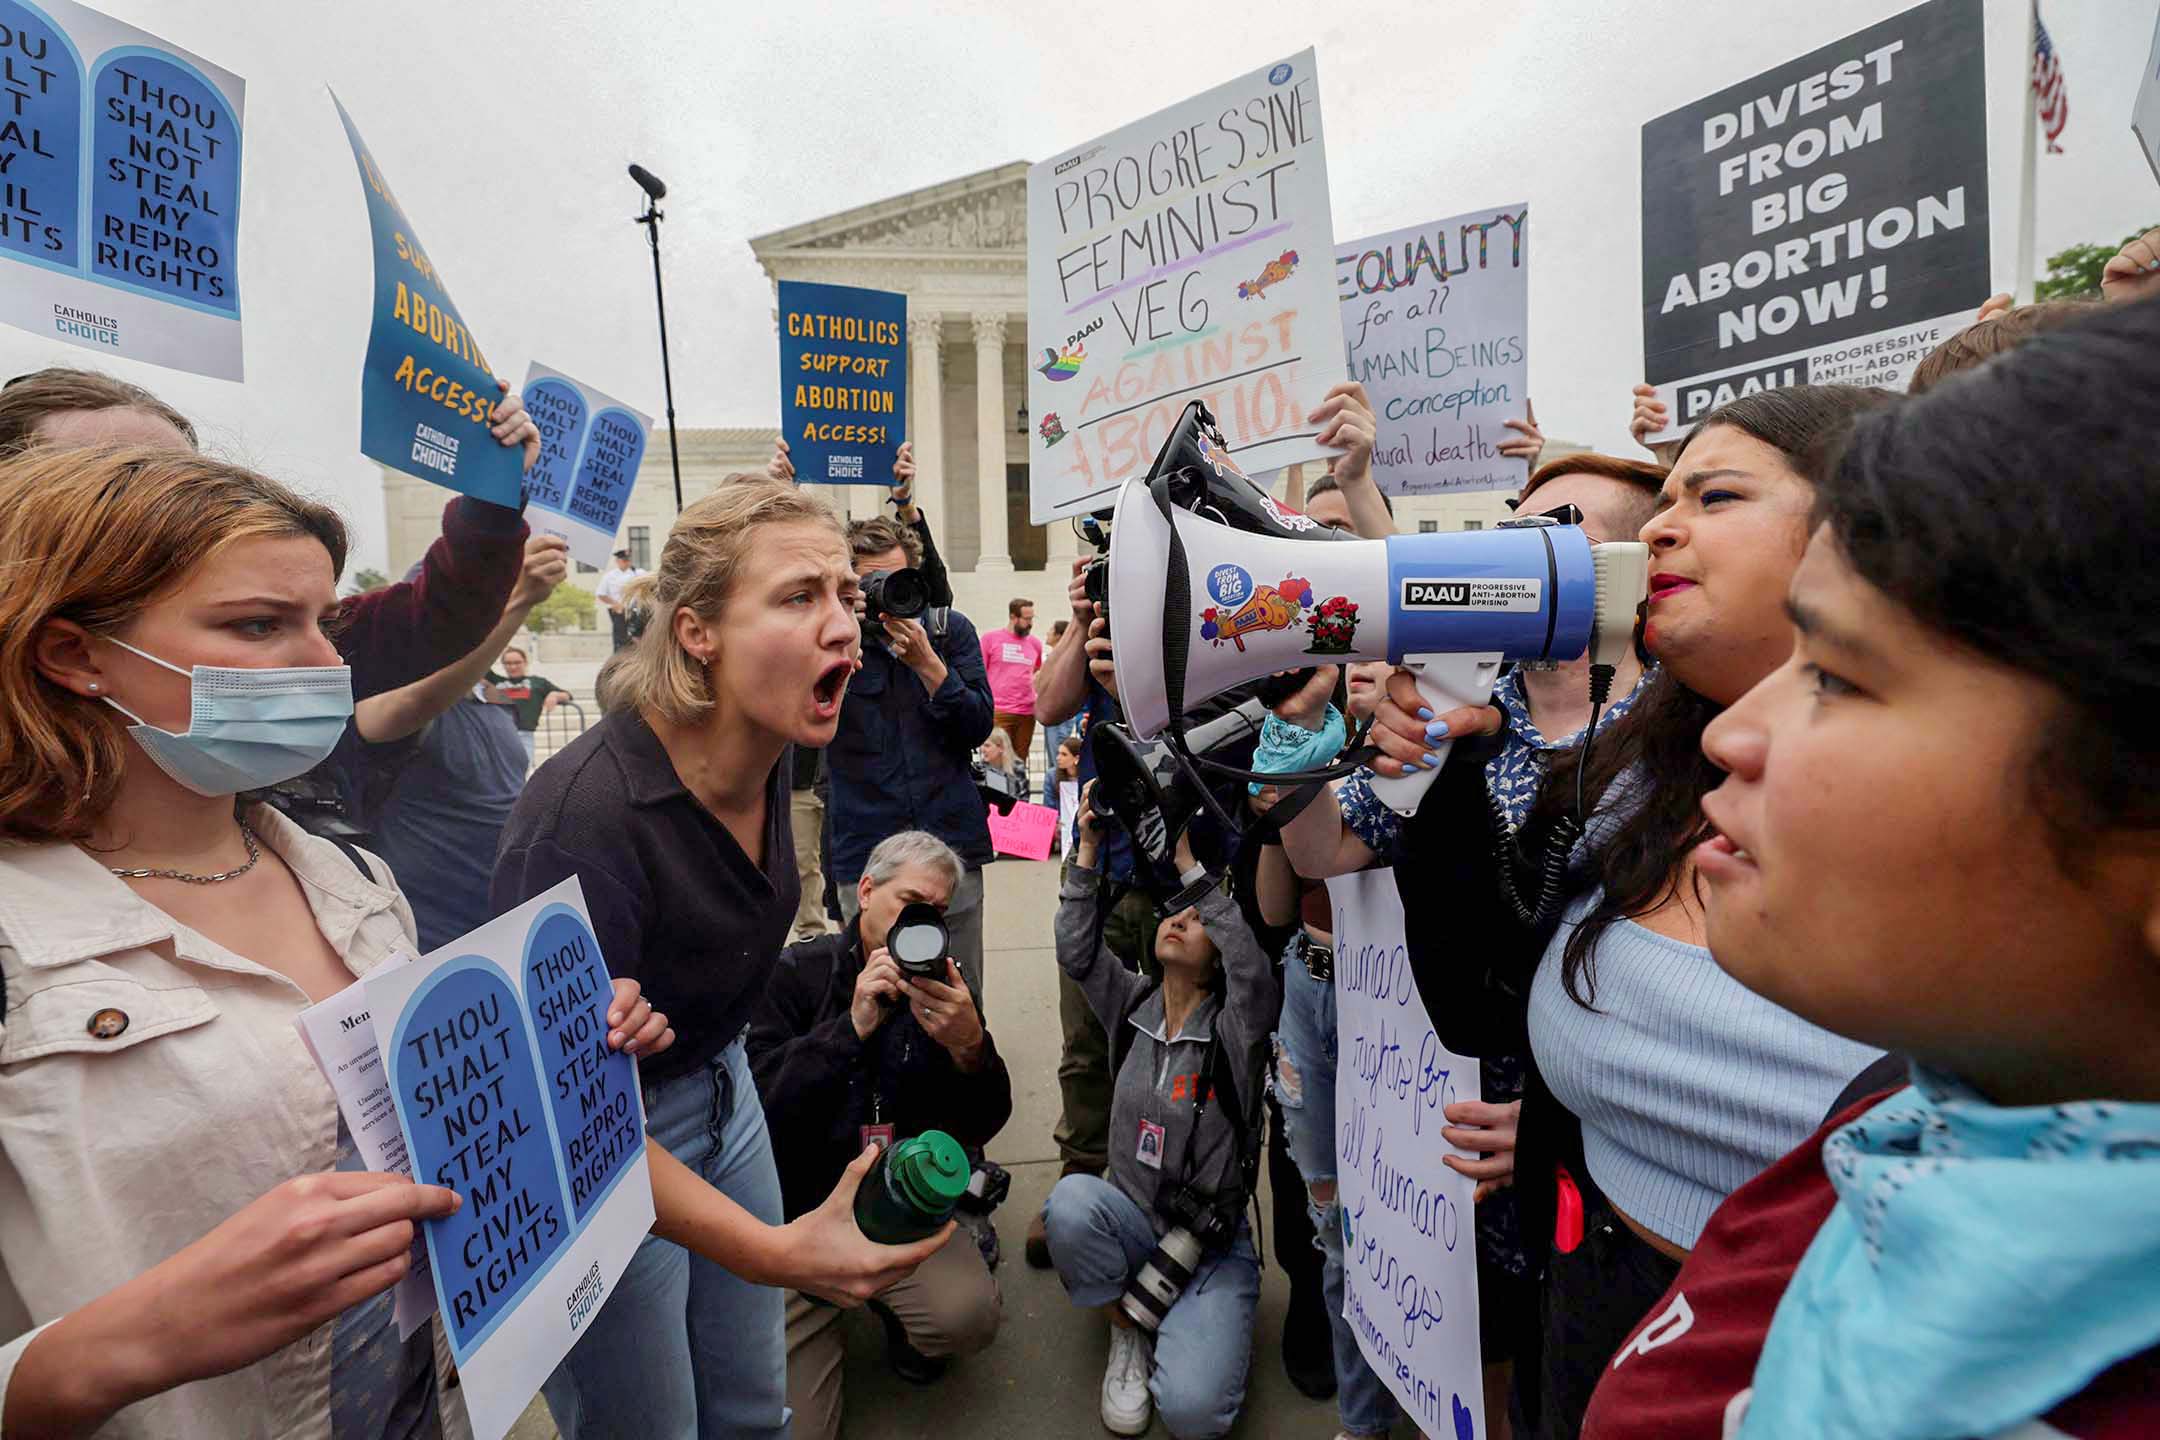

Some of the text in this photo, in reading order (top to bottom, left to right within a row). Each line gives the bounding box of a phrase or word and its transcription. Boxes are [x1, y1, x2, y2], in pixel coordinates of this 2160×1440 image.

[114, 68, 216, 129] THOU
[1703, 39, 1904, 154] DIVEST
[107, 97, 223, 159] SHALT
[1719, 101, 1883, 197] FROM
[129, 134, 202, 179] NOT
[1055, 77, 1314, 235] PROGRESSIVE
[108, 157, 219, 216] STEAL
[1751, 172, 1849, 236] BIG
[139, 197, 190, 231] MY
[1056, 160, 1296, 303] FEMINIST
[104, 214, 219, 268] REPRO
[1336, 209, 1528, 301] EQUALITY
[1660, 186, 1966, 314] ABORTION
[98, 242, 225, 297] RIGHTS
[54, 303, 118, 329] CATHOLICS
[55, 318, 119, 346] CHOICE
[787, 311, 900, 347] CATHOLICS
[1066, 316, 1104, 348] PAAU
[1111, 270, 1209, 347] VEG
[1352, 286, 1450, 350] for all
[1718, 264, 1889, 349] NOW!
[800, 351, 890, 378] SUPPORT
[1080, 309, 1298, 416] AGAINST
[1424, 327, 1524, 379] BEINGS
[1812, 328, 1941, 367] PROGRESSIVE
[534, 388, 580, 417] THOU
[794, 384, 895, 414] ABORTION
[1384, 377, 1512, 421] conception
[415, 423, 460, 452] CATHOLICS
[592, 430, 637, 460] SHALT
[595, 446, 625, 468] NOT
[600, 417, 639, 445] THOU
[803, 421, 887, 444] ACCESS!
[1424, 424, 1498, 467] death
[411, 442, 457, 475] CHOICE
[585, 458, 626, 486] STEAL
[591, 475, 615, 493] MY
[828, 455, 864, 466] CATHOLICS
[828, 466, 864, 478] CHOICE
[570, 498, 617, 527] RIGHTS
[576, 485, 619, 512] REPRO
[1216, 572, 1239, 586] FROM
[1219, 580, 1243, 598] BIG
[1411, 586, 1465, 602] PAAU
[1471, 583, 1527, 591] PROGRESSIVE
[1471, 591, 1537, 599] ANTI-ABORTION
[1471, 599, 1509, 607] UPRISING
[531, 935, 587, 992] THOU
[1338, 906, 1413, 1007] human
[538, 965, 599, 1031] SHALT
[408, 992, 500, 1069] THOU
[559, 1003, 600, 1057] NOT
[415, 1027, 511, 1119] SHALT
[1353, 1017, 1413, 1108] rights
[443, 1075, 504, 1147] NOT
[580, 1071, 607, 1118] MY
[436, 1108, 531, 1191] STEAL
[568, 1090, 628, 1170] REPRO
[470, 1157, 513, 1218] MY
[572, 1116, 637, 1209] RIGHTS
[1342, 1097, 1459, 1253] all human
[463, 1187, 541, 1269] CIVIL
[453, 1205, 559, 1329] RIGHTS
[566, 1260, 601, 1311] CATHOLICS
[1354, 1195, 1444, 1349] beings
[570, 1275, 605, 1332] CHOICE
